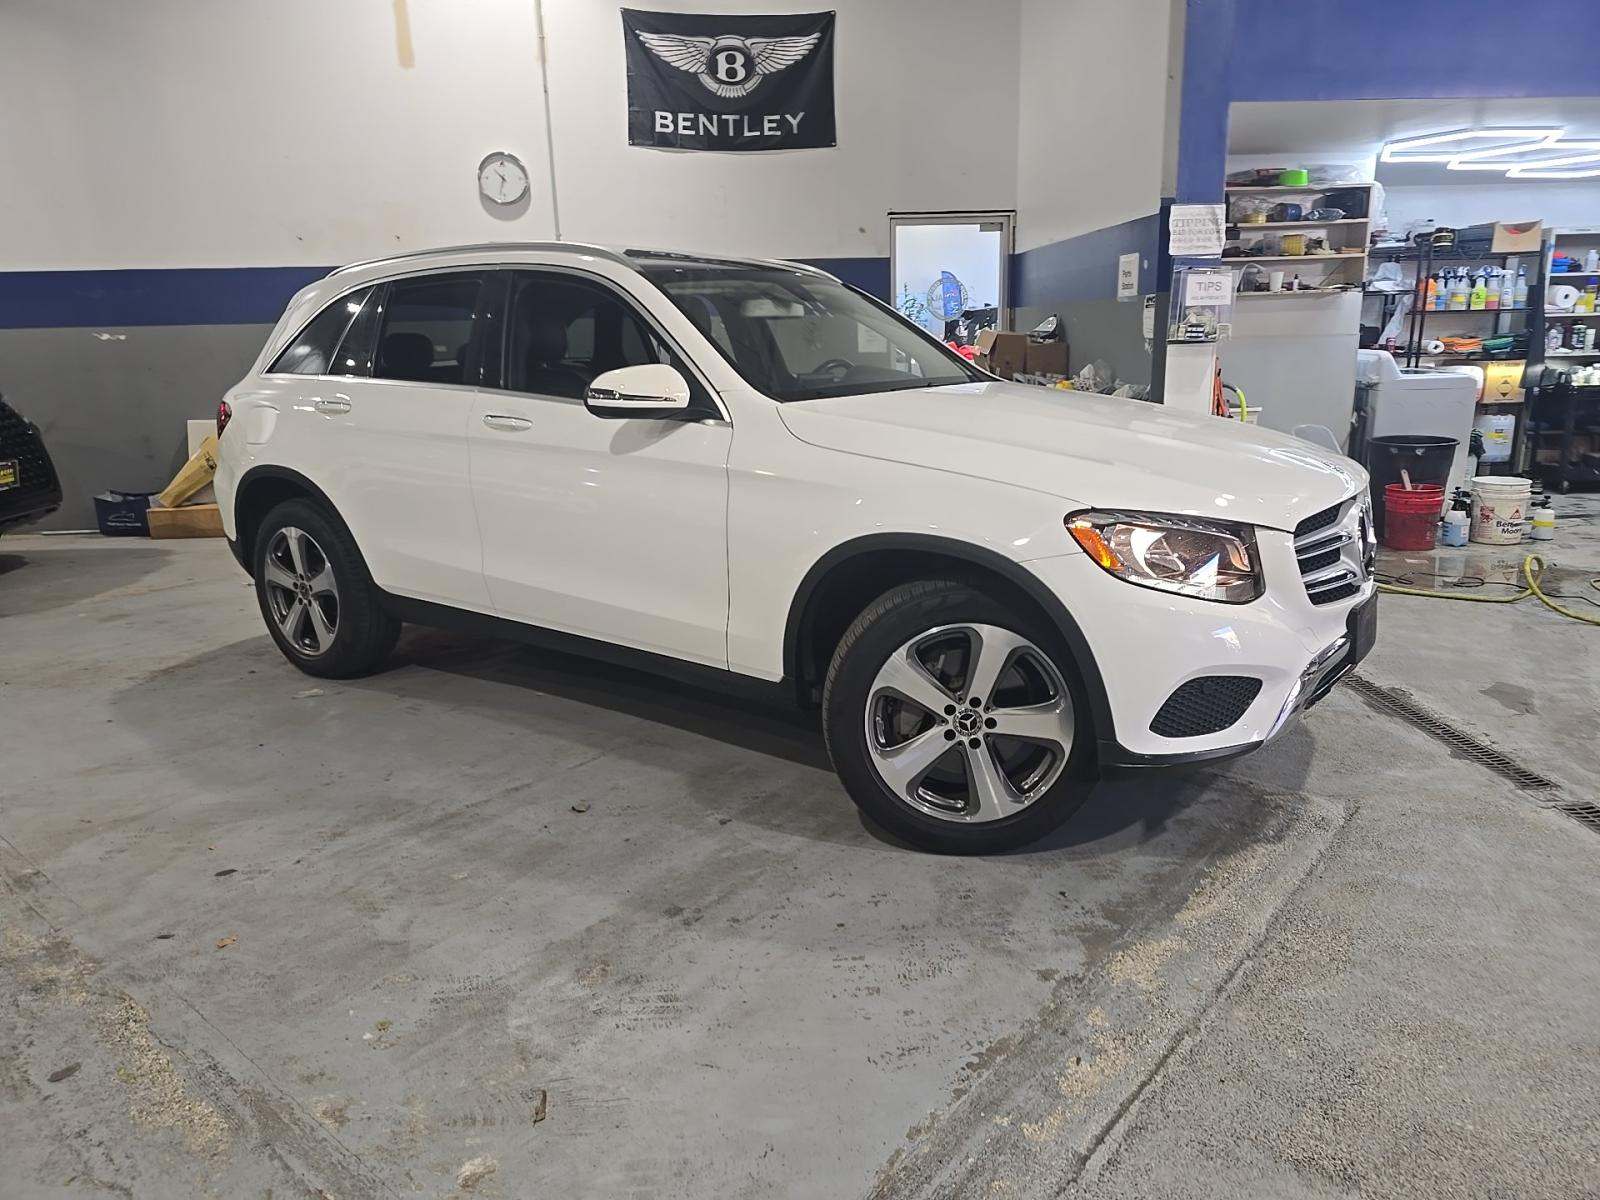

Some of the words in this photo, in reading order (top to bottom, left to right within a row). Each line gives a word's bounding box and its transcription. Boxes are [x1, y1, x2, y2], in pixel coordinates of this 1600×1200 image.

[716, 50, 746, 82] B
[654, 111, 805, 137] BENTLEY
[1195, 281, 1222, 292] TIPS
